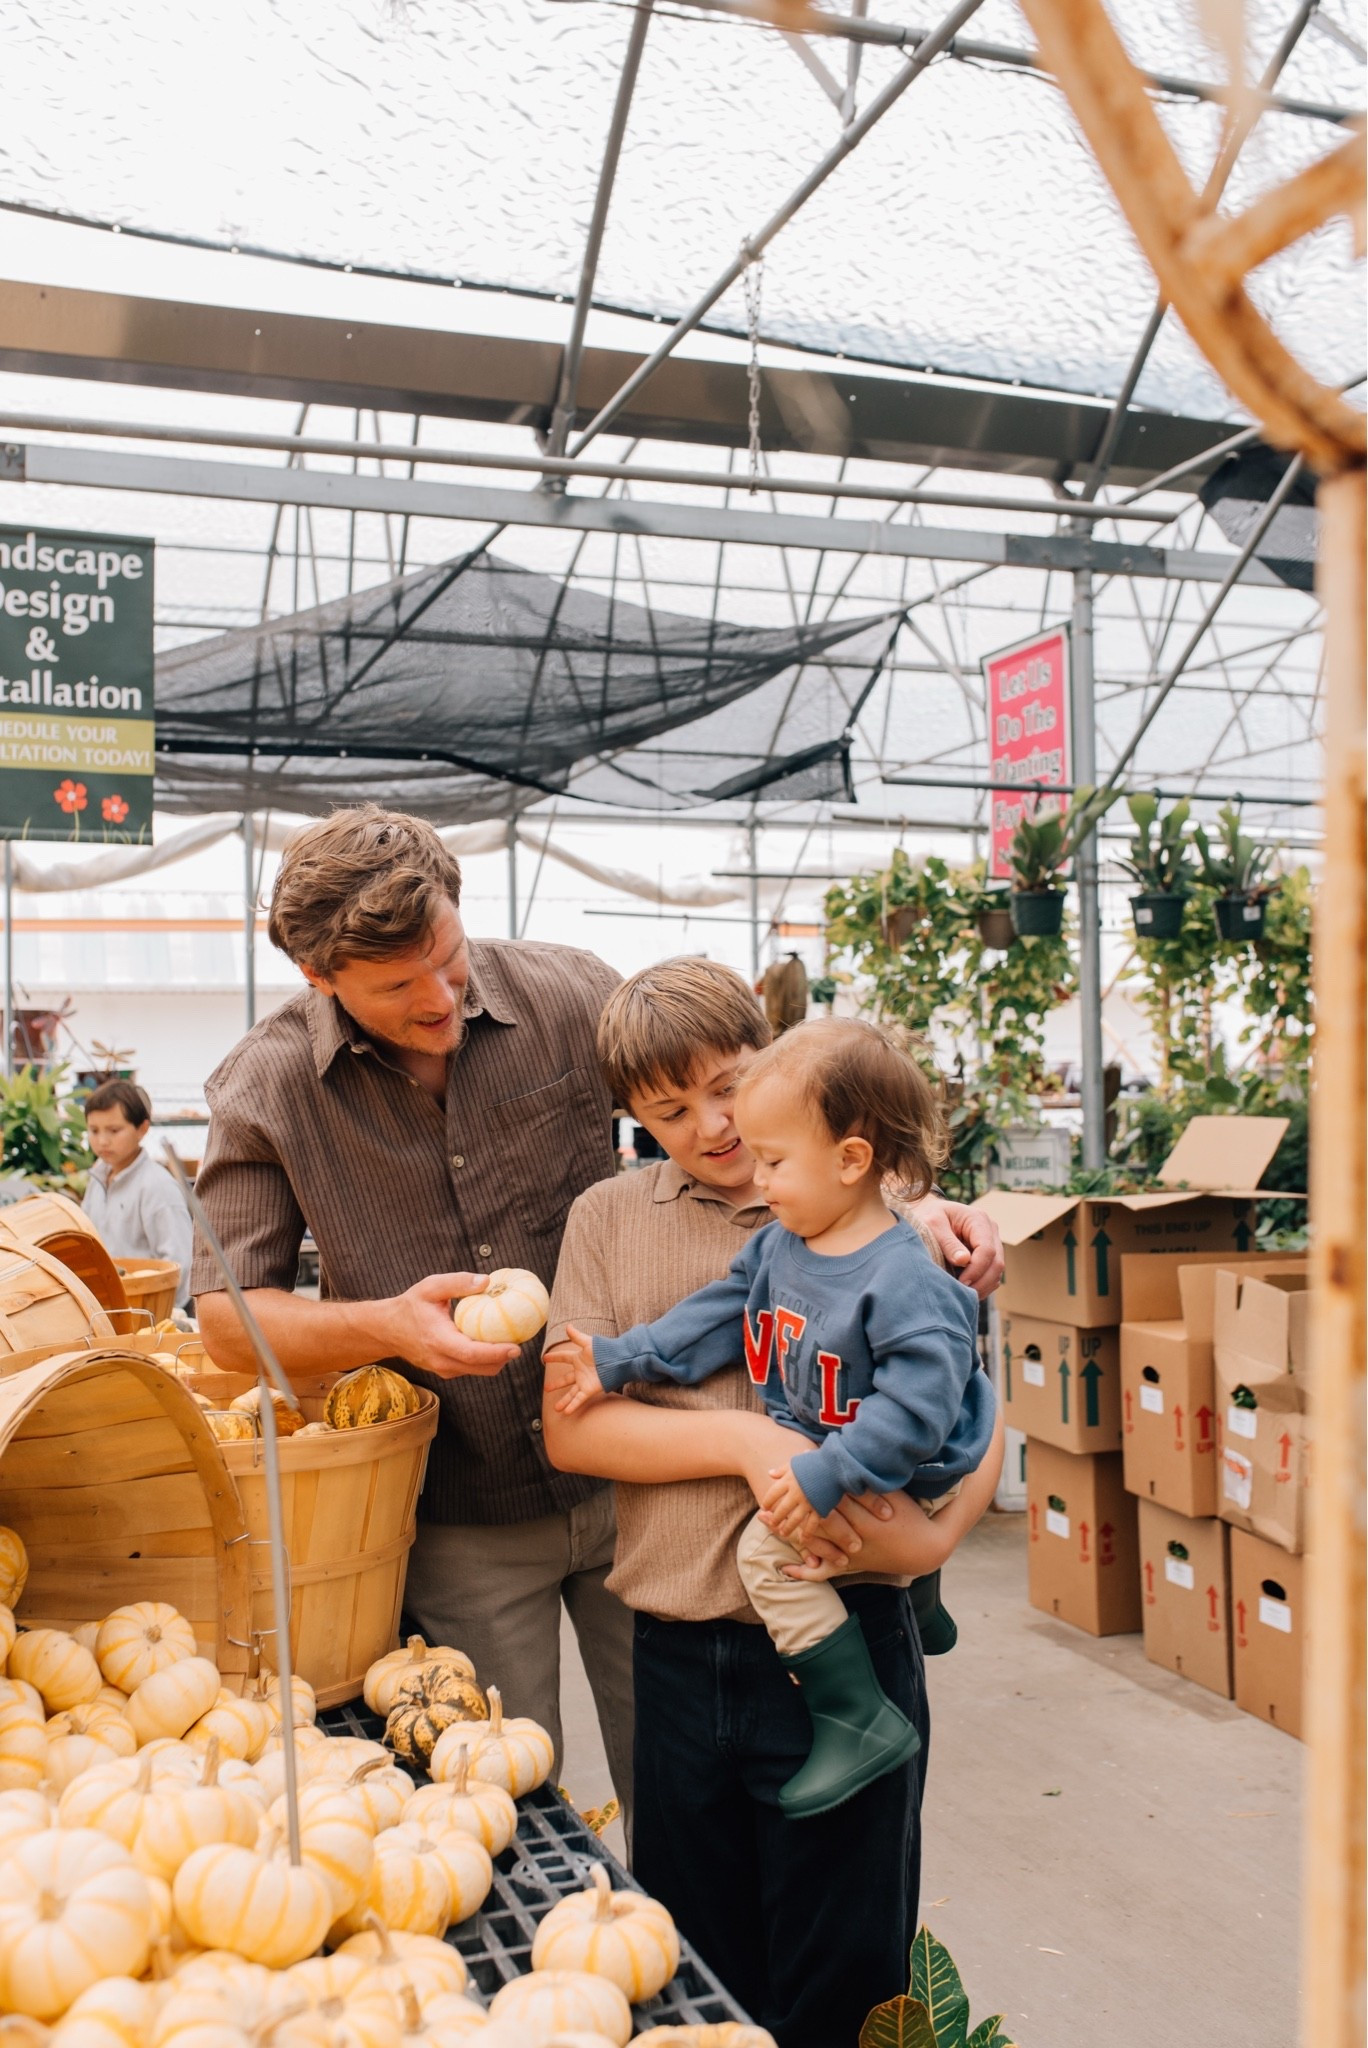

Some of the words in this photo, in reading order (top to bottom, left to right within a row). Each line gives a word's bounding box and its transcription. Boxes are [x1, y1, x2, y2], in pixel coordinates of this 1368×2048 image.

[0, 579, 115, 636] esign
[25, 626, 60, 663] &
[999, 670, 1027, 702] Let
[1027, 657, 1052, 692] Us
[66, 724, 118, 744] YOUR
[996, 713, 1022, 746] Do
[1022, 699, 1056, 737] The
[82, 747, 150, 768] TODAY!
[1081, 1336, 1102, 1359] UP
